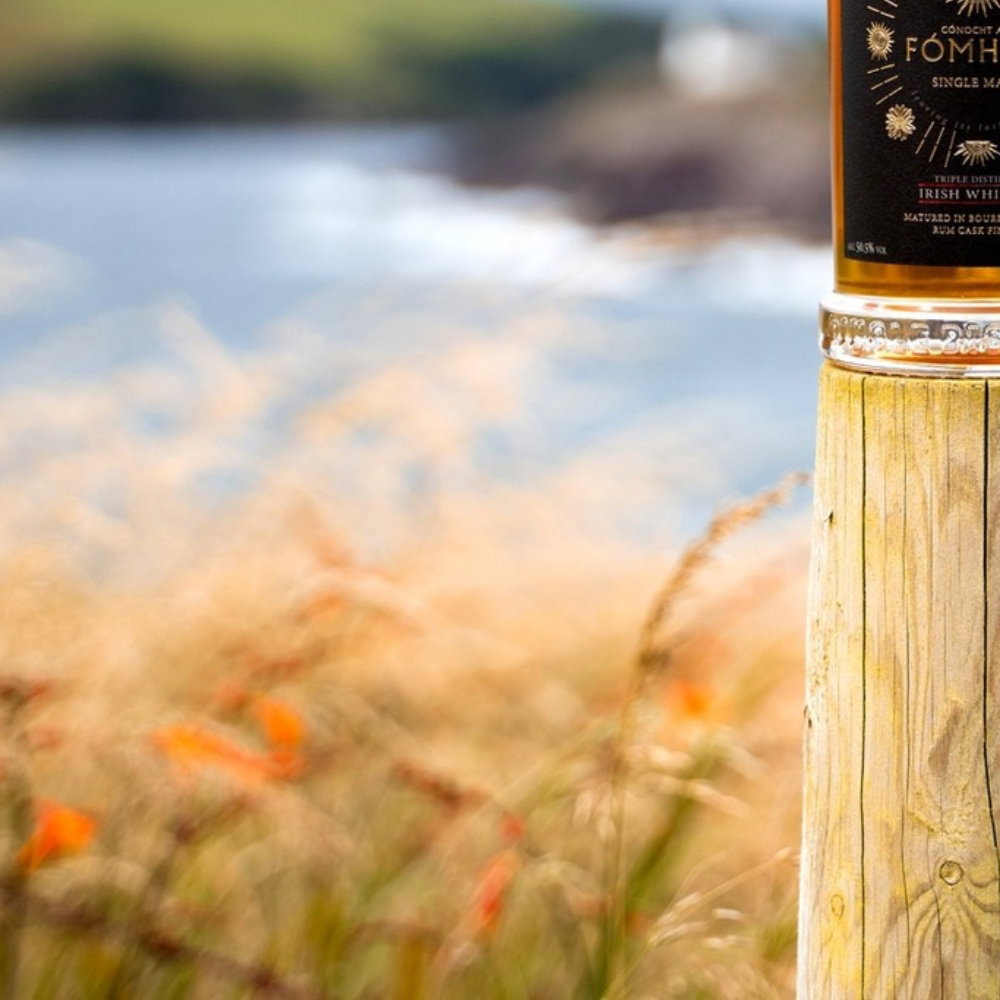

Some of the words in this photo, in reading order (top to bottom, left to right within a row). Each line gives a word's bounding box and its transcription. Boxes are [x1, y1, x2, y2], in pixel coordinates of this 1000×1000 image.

[940, 25, 992, 35] CÓNOCHT
[931, 77, 979, 88] SINGLE
[934, 175, 967, 183] TRIPLE
[918, 188, 960, 199] IRISH
[903, 213, 950, 222] MATURED
[953, 213, 966, 223] IN
[932, 226, 956, 235] RUM
[957, 226, 985, 235] CASK
